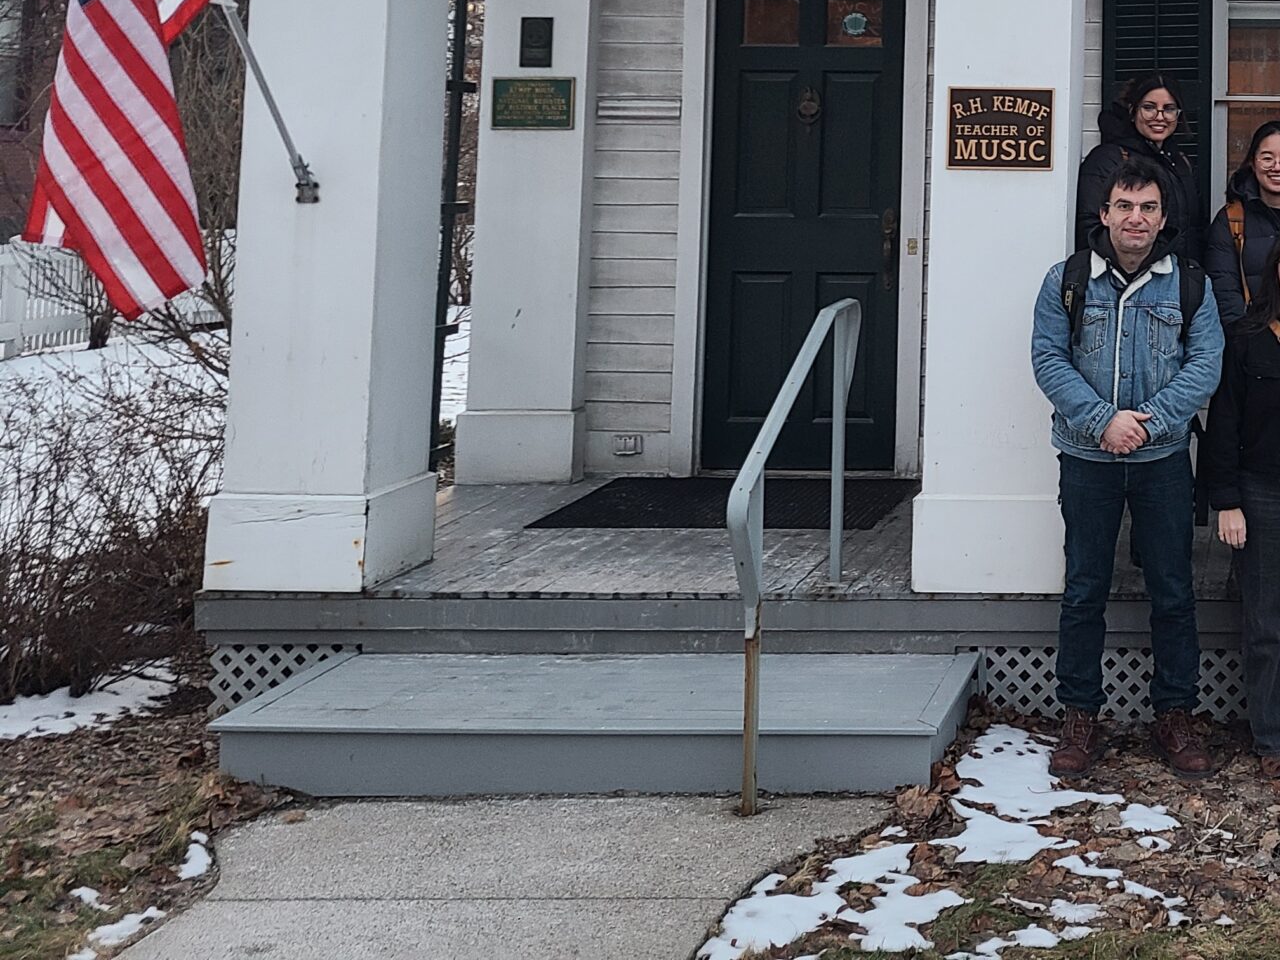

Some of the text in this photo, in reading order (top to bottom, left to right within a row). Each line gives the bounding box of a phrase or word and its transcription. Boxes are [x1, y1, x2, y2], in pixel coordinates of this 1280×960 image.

[952, 95, 1051, 121] R.H. KEMPF
[955, 124, 1045, 137] TEACHER OF
[954, 139, 1046, 161] MUSIC
